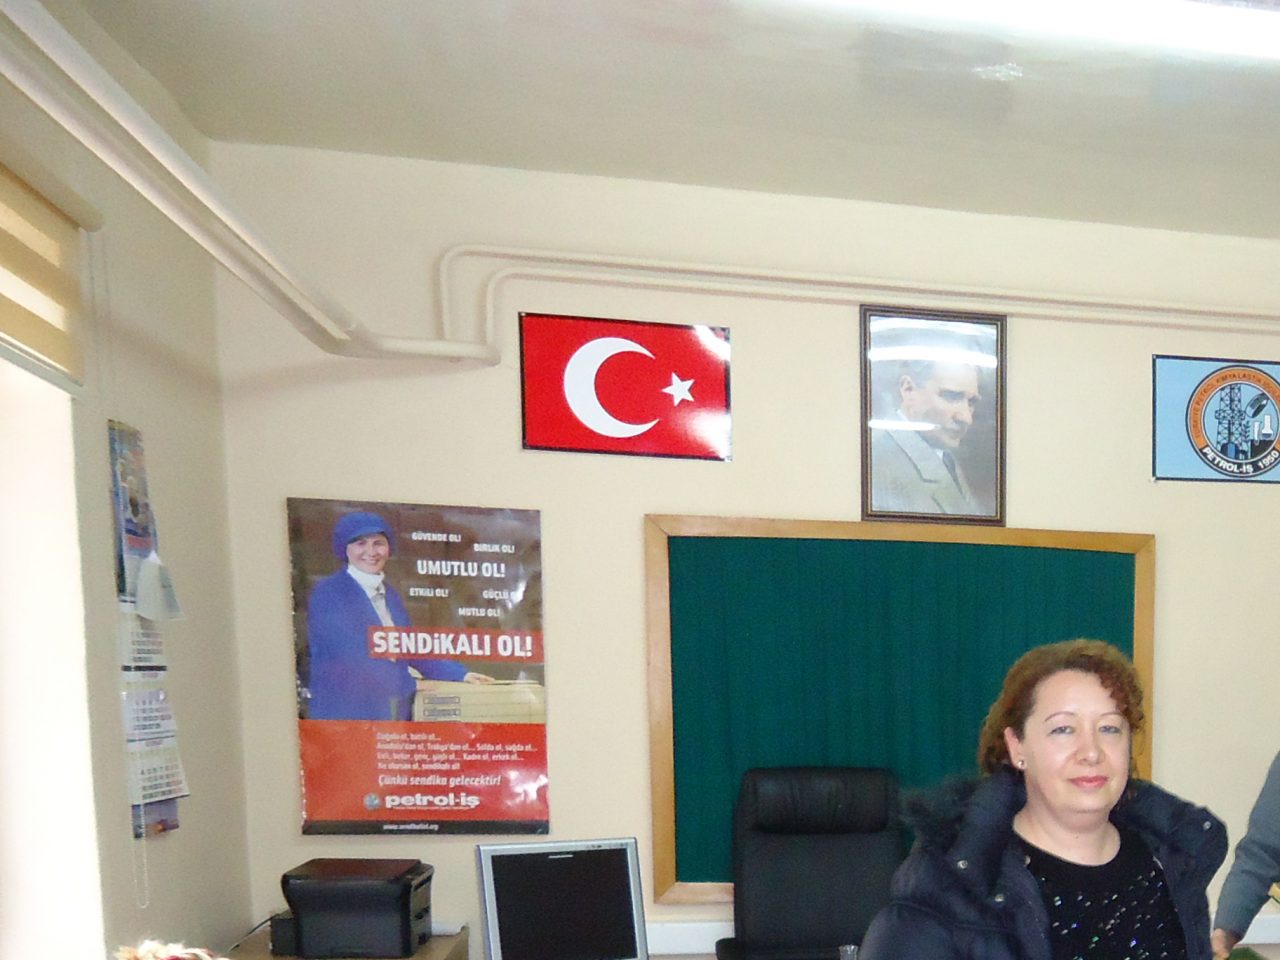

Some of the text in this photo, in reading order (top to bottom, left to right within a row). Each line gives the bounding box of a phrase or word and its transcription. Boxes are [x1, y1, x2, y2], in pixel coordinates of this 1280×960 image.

[1257, 450, 1279, 469] 1950
[448, 533, 462, 543] OL!
[501, 544, 515, 554] OL!
[416, 560, 506, 578] UMUTLU OL!
[435, 588, 449, 598] OL!
[458, 607, 486, 617] MUTLU
[497, 634, 533, 657] OL!
[410, 774, 447, 786] sendika
[449, 775, 502, 788] gelecektir!
